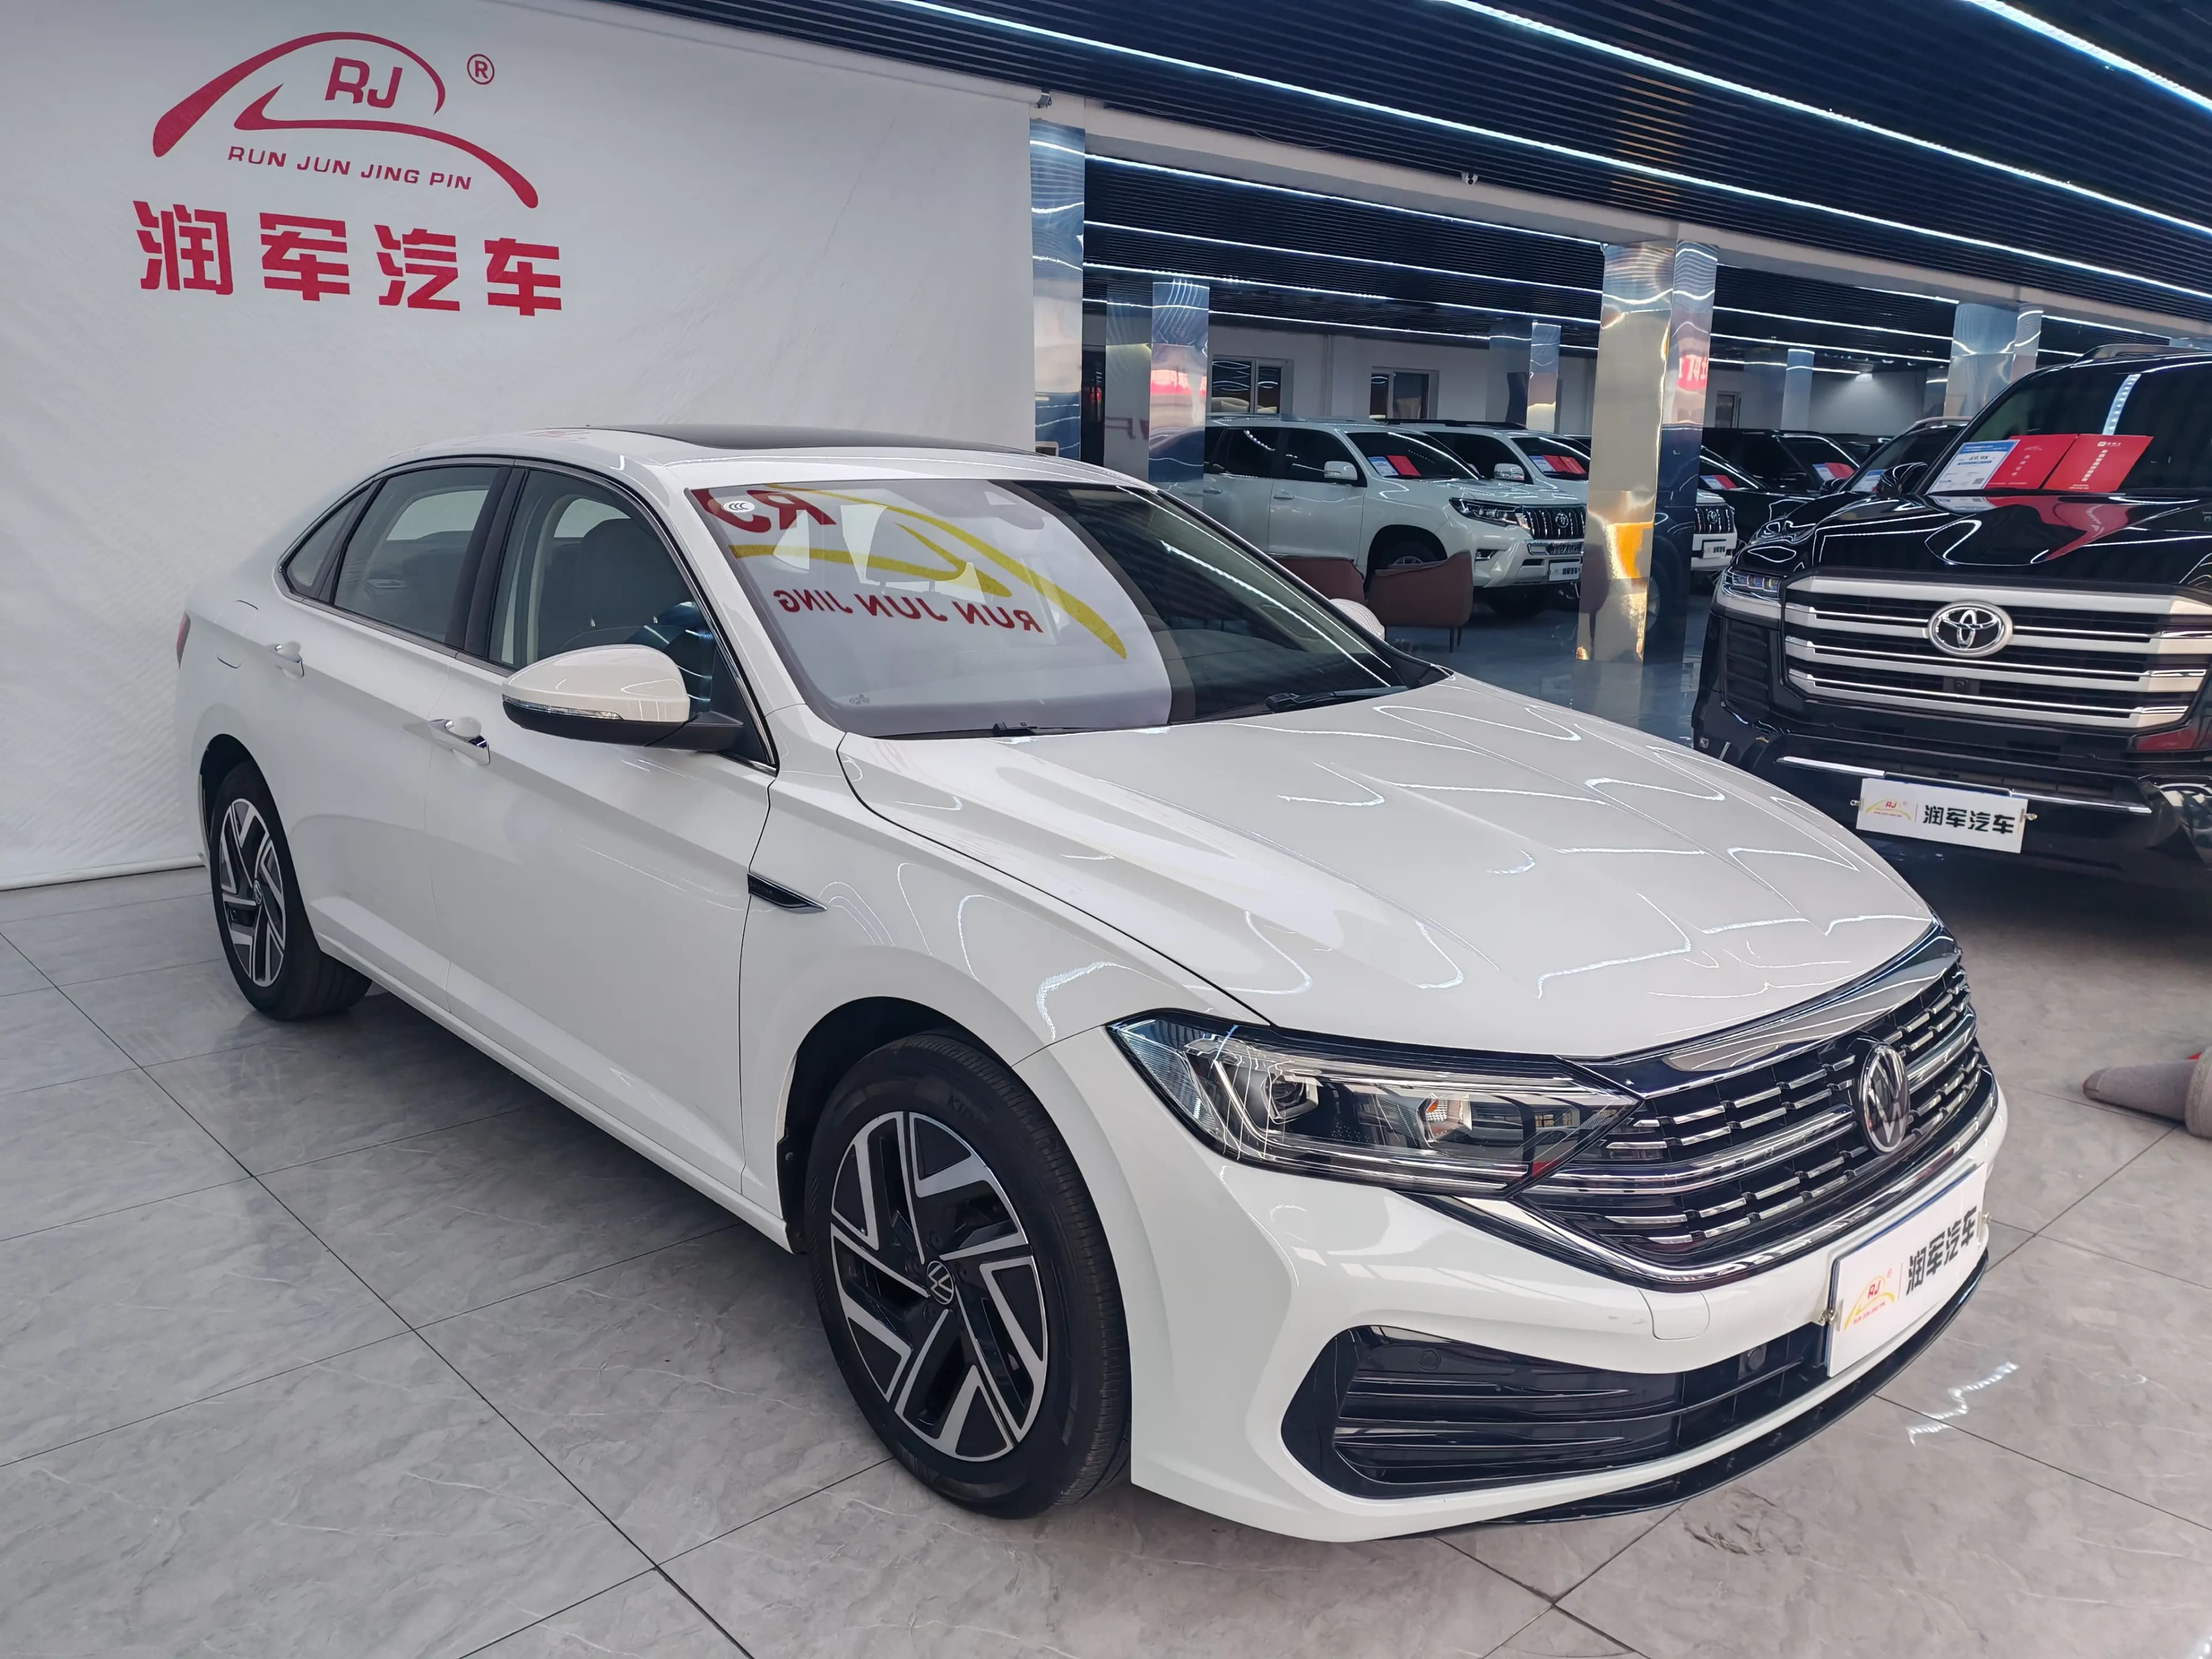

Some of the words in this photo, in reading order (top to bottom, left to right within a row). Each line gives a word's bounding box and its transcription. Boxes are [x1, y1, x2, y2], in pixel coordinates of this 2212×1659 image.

[325, 57, 403, 109] RJ
[228, 146, 286, 167] RUN
[297, 156, 350, 175] JUN
[360, 165, 419, 184] JING
[429, 173, 471, 190] PIN
[133, 200, 562, 316] 润军汽车
[1923, 805, 2016, 834] 润军汽车
[1906, 1206, 1978, 1296] 润军汽车
